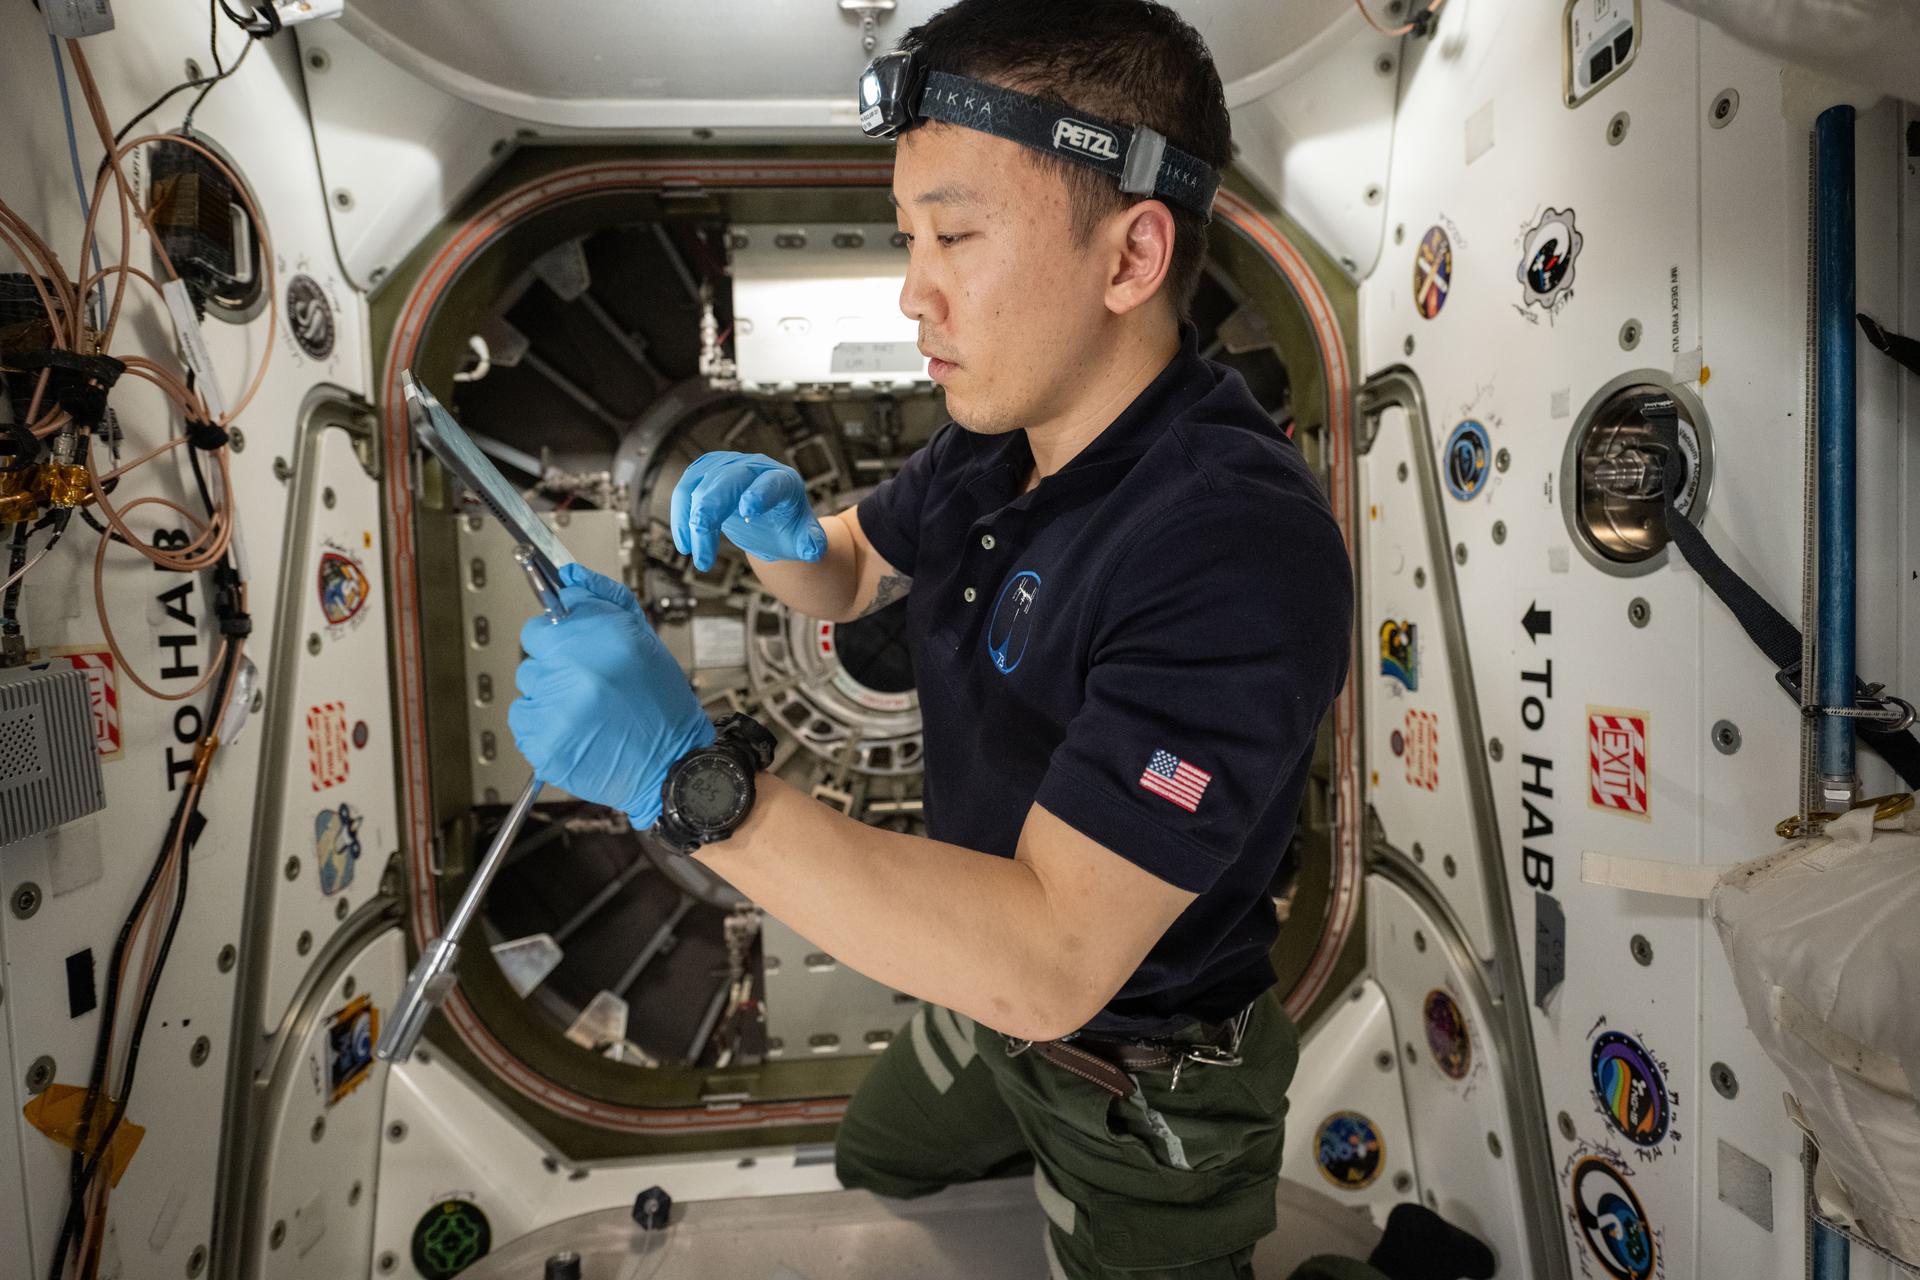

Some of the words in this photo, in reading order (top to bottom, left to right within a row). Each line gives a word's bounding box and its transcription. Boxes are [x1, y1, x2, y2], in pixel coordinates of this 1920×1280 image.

[924, 86, 991, 115] TIKKA
[1053, 119, 1120, 160] PETZL
[1671, 285, 1679, 312] DECK
[1671, 312, 1679, 335] FWD
[1672, 335, 1680, 353] VLV
[1687, 462, 1701, 498] Access
[153, 527, 200, 680] HAB
[1520, 659, 1553, 732] TO
[166, 704, 203, 791] TO
[1602, 730, 1633, 797] EXIT
[1520, 753, 1554, 892] HAB
